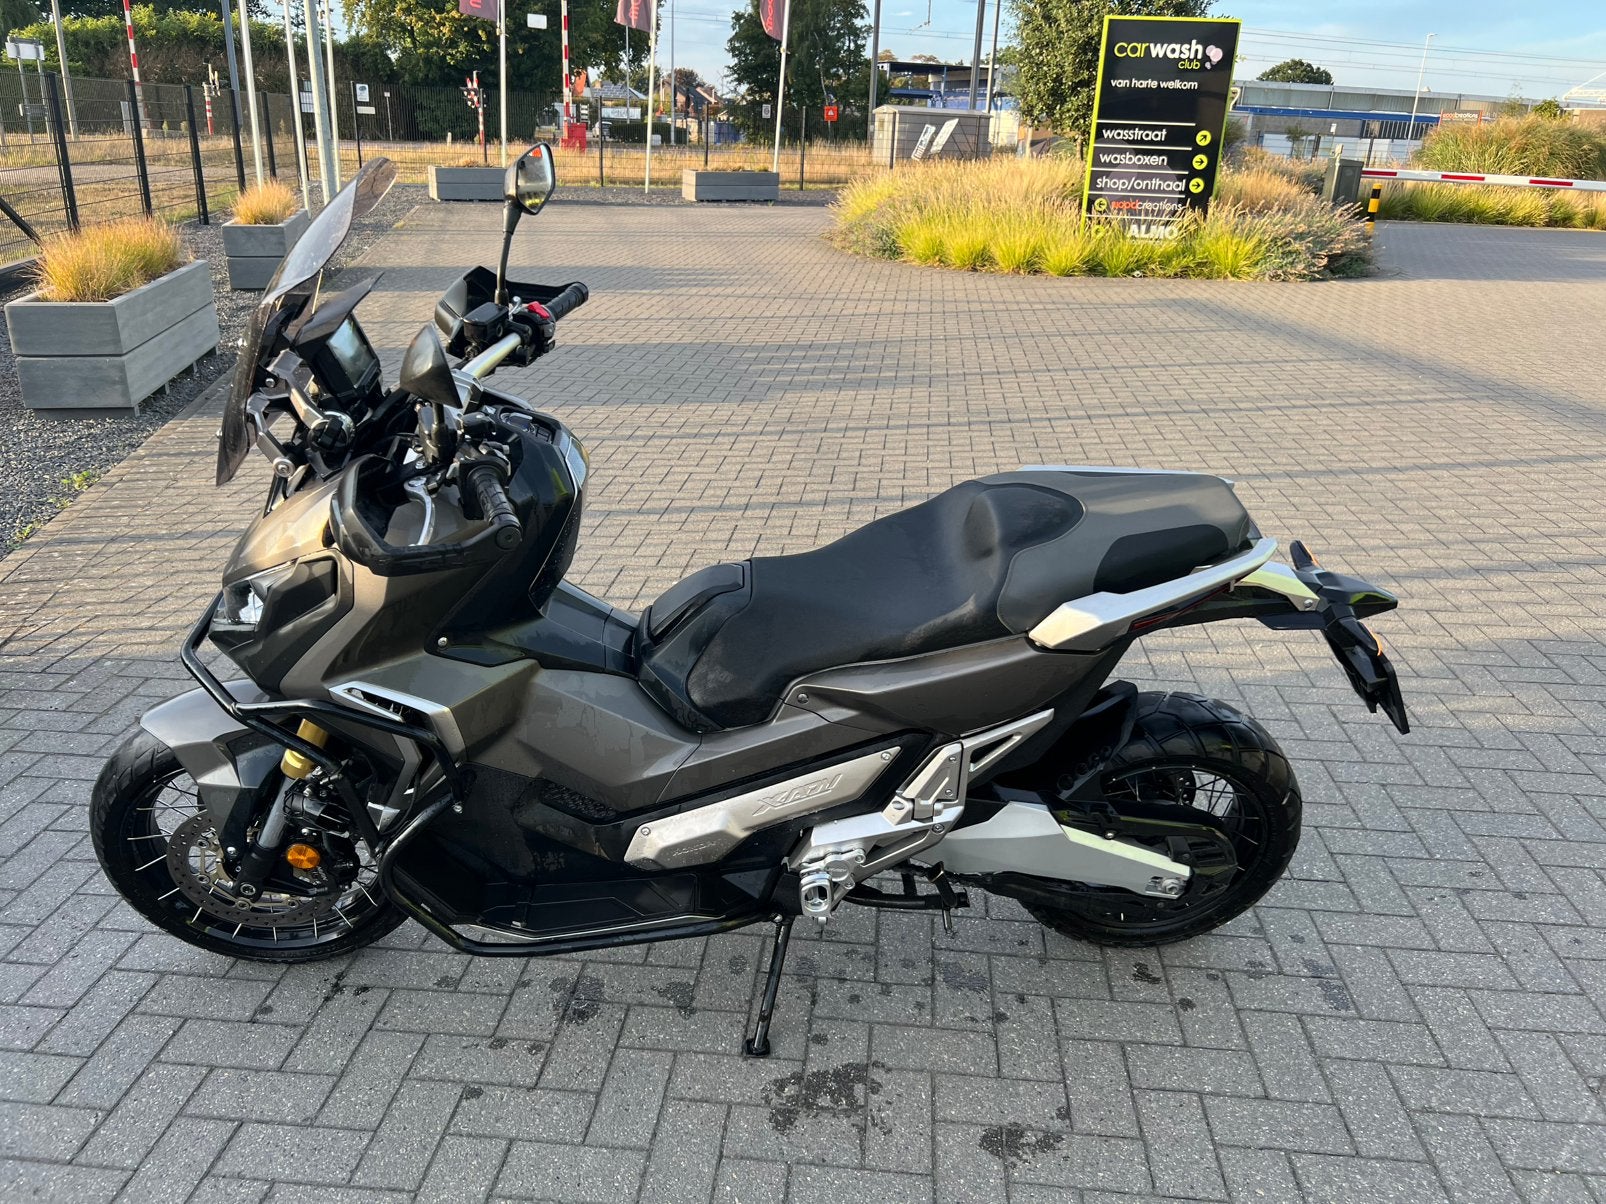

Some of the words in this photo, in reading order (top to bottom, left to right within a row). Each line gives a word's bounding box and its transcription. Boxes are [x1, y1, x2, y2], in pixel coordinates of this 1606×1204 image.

[1113, 39, 1203, 60] carwash
[1178, 59, 1200, 70] club
[1111, 79, 1130, 88] van
[1131, 78, 1158, 89] harte
[1160, 79, 1198, 90] welkom
[1102, 128, 1167, 141] wasstraat
[1099, 152, 1168, 166] wasboxen
[1096, 176, 1186, 192] shop/onthaal
